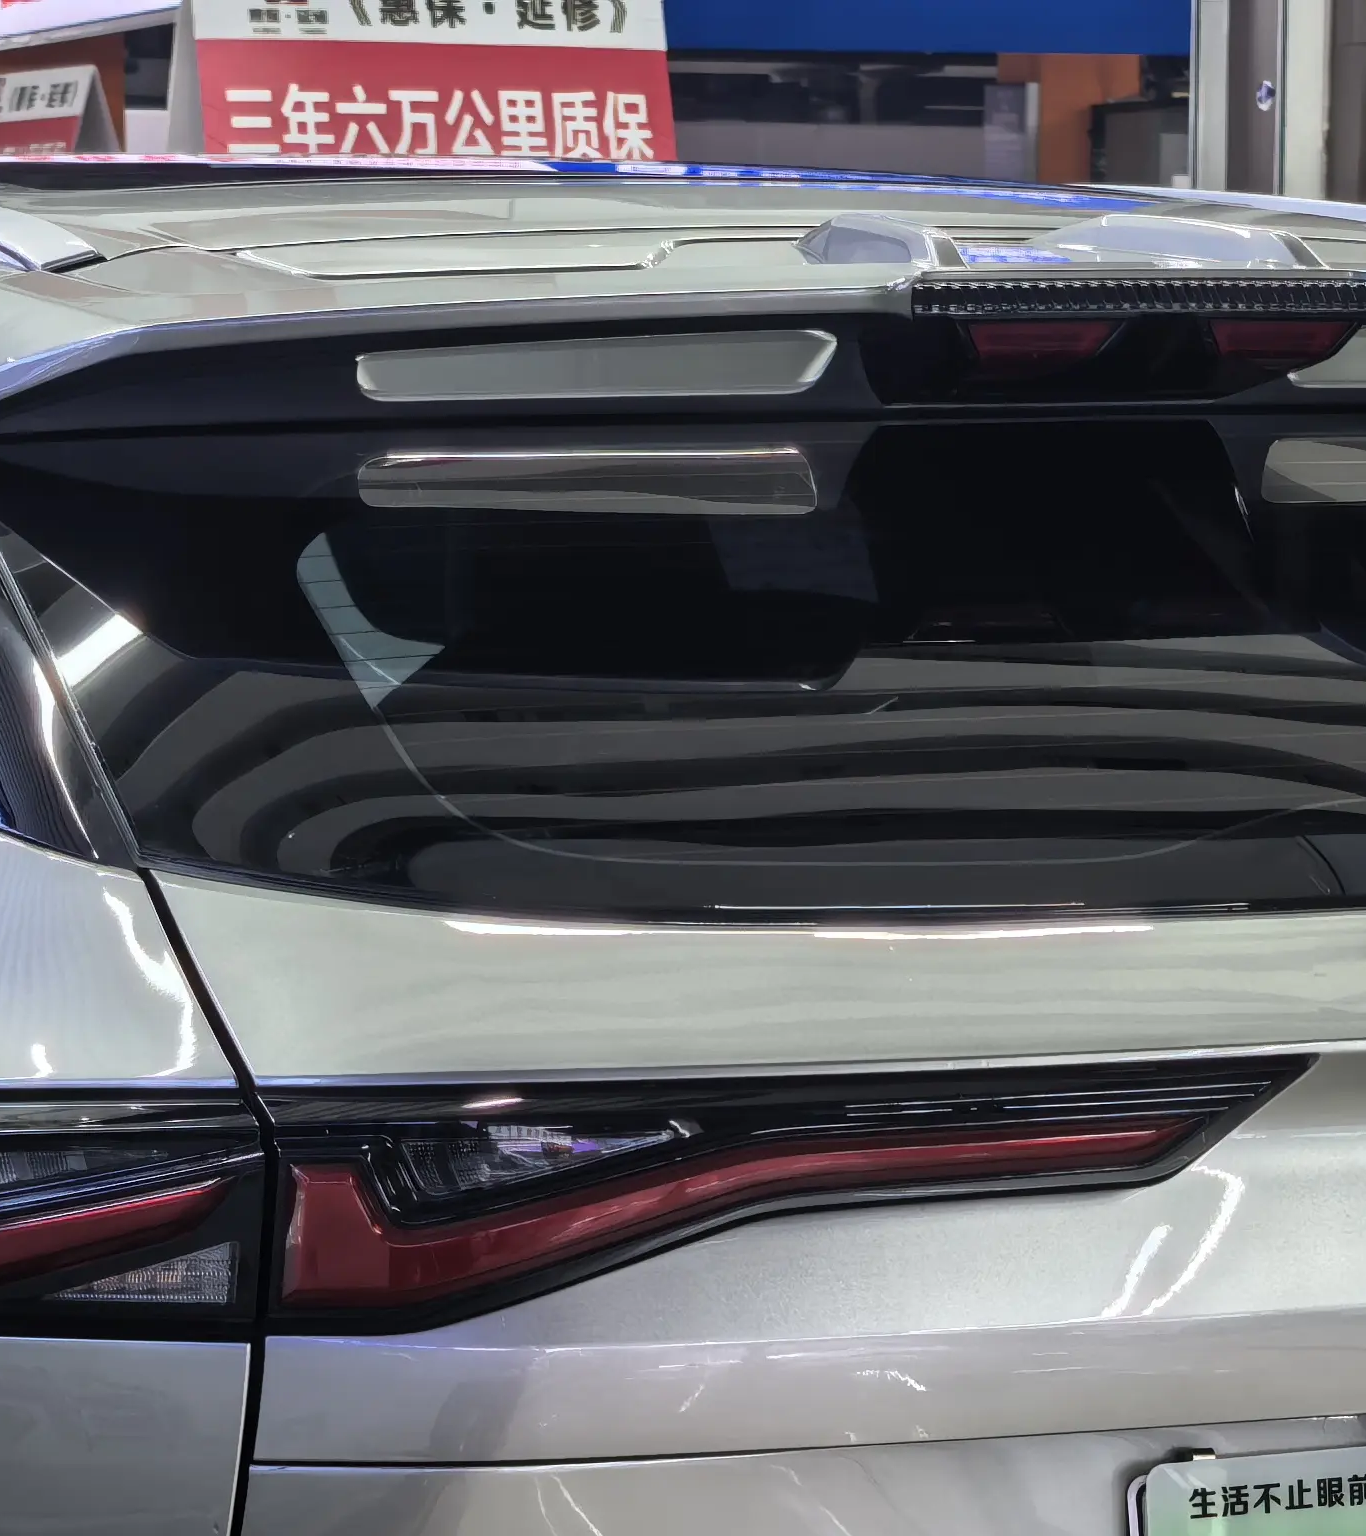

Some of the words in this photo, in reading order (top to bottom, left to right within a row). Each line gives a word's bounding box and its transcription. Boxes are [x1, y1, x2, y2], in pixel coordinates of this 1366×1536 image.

[225, 83, 654, 160] 三年六万公里质保
